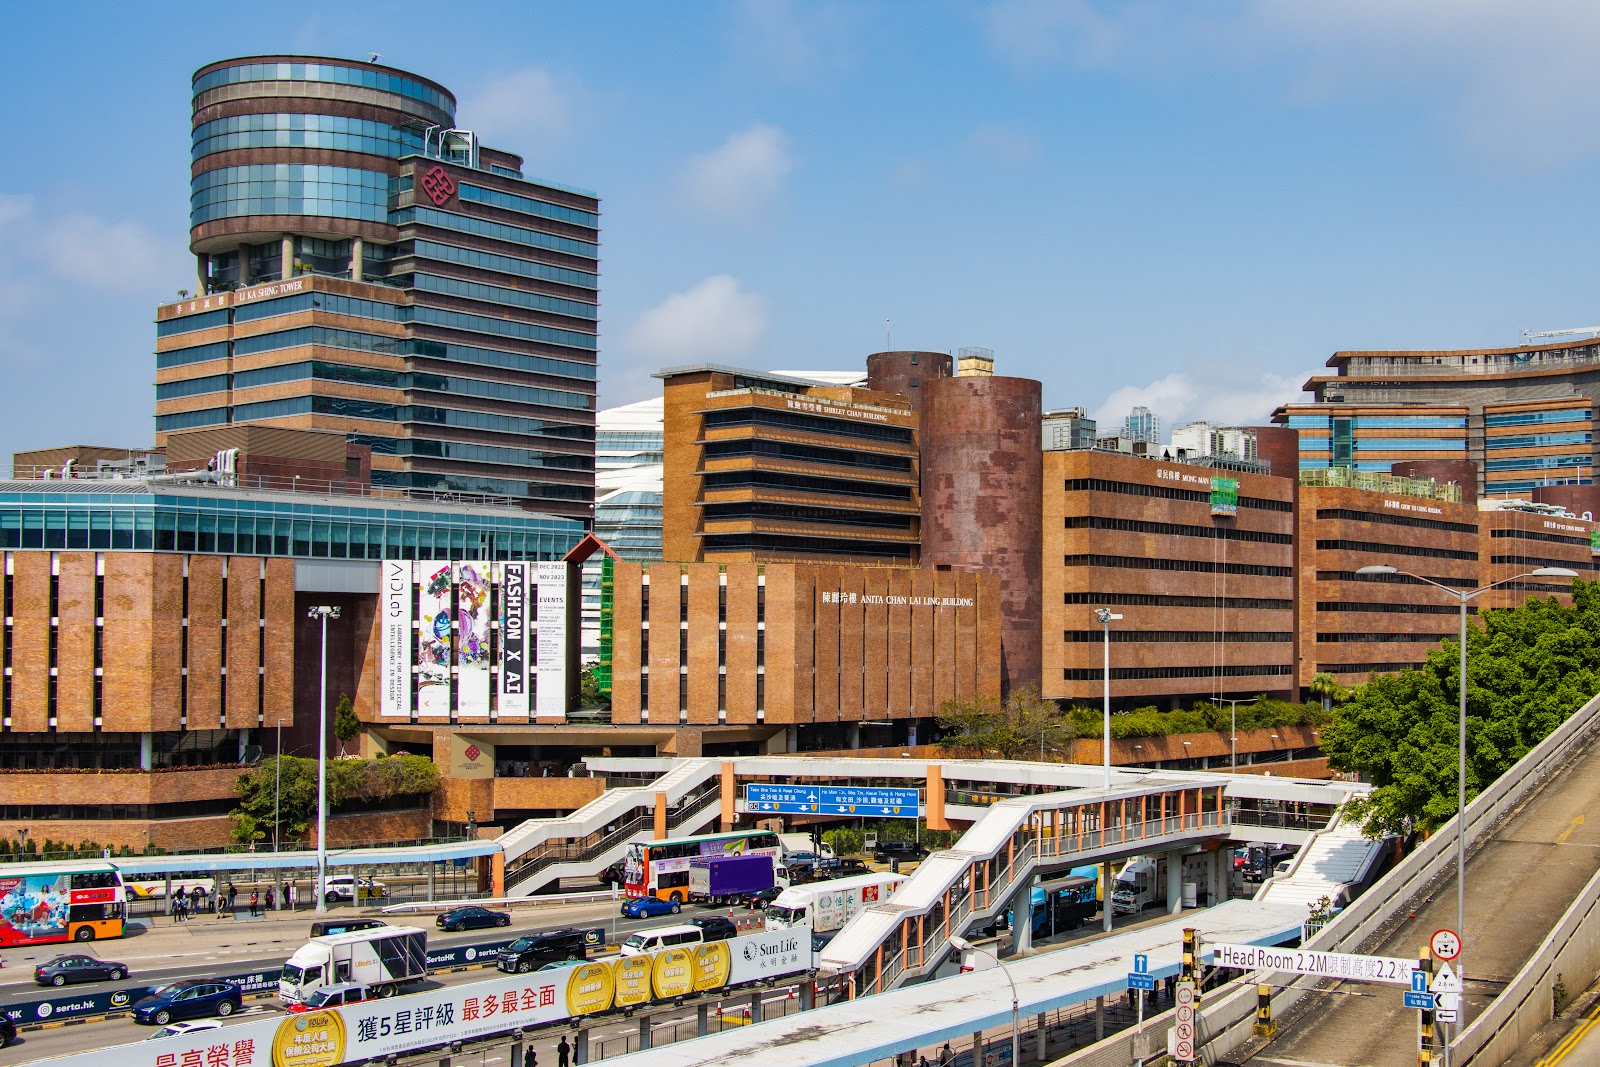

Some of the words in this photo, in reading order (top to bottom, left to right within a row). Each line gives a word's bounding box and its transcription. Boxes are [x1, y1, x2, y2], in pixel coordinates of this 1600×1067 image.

[240, 292, 246, 301] LI
[247, 289, 256, 300] KA
[258, 286, 278, 298] SHING
[280, 281, 302, 293] TOWER
[824, 406, 846, 415] SHIRLEY
[846, 409, 862, 418] CHAN
[864, 412, 888, 421] BUILDING
[1182, 475, 1198, 483] MONG
[506, 564, 521, 640] FASHION
[861, 595, 883, 604] ANITA
[886, 596, 906, 605] CHAN
[910, 597, 921, 605] LAI
[923, 598, 940, 606] LING
[942, 598, 973, 607] BUILDING
[506, 650, 521, 662] X
[506, 671, 521, 693] AI
[760, 944, 778, 956] Sun
[780, 938, 798, 952] Life
[426, 953, 454, 964] SertaHK
[760, 954, 797, 969] 永明金融
[1223, 946, 1255, 966] Head
[1259, 950, 1293, 970] Room
[114, 994, 126, 1002] Serta
[56, 1001, 94, 1012] serta.hk
[358, 1002, 454, 1042] 獲5星評級
[462, 984, 556, 1021] 最多最全面
